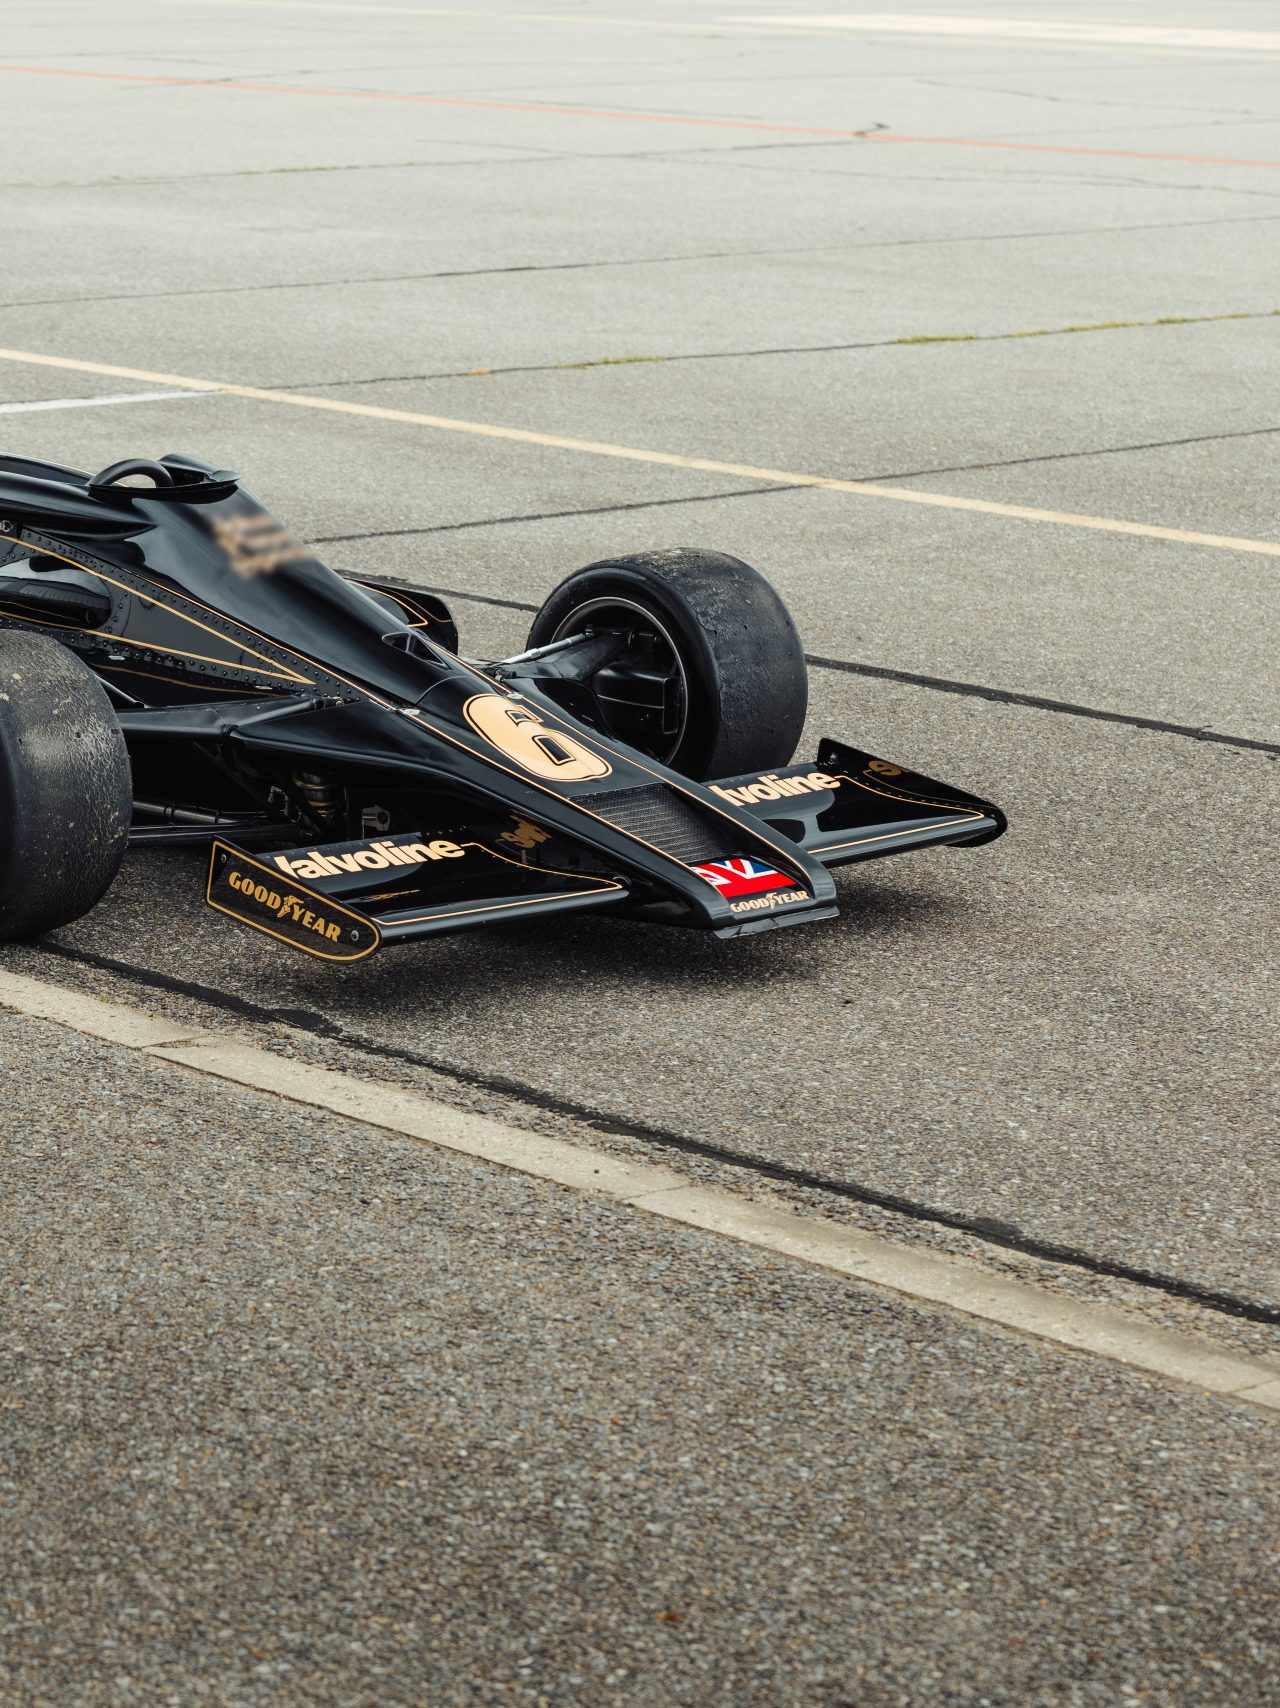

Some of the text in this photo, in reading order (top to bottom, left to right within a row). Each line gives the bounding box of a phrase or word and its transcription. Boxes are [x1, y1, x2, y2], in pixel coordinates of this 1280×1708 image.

[462, 693, 613, 782] 6
[708, 772, 841, 807] lvoline
[228, 871, 342, 943] GOODYEAR
[729, 889, 810, 913] GOODYEAR
